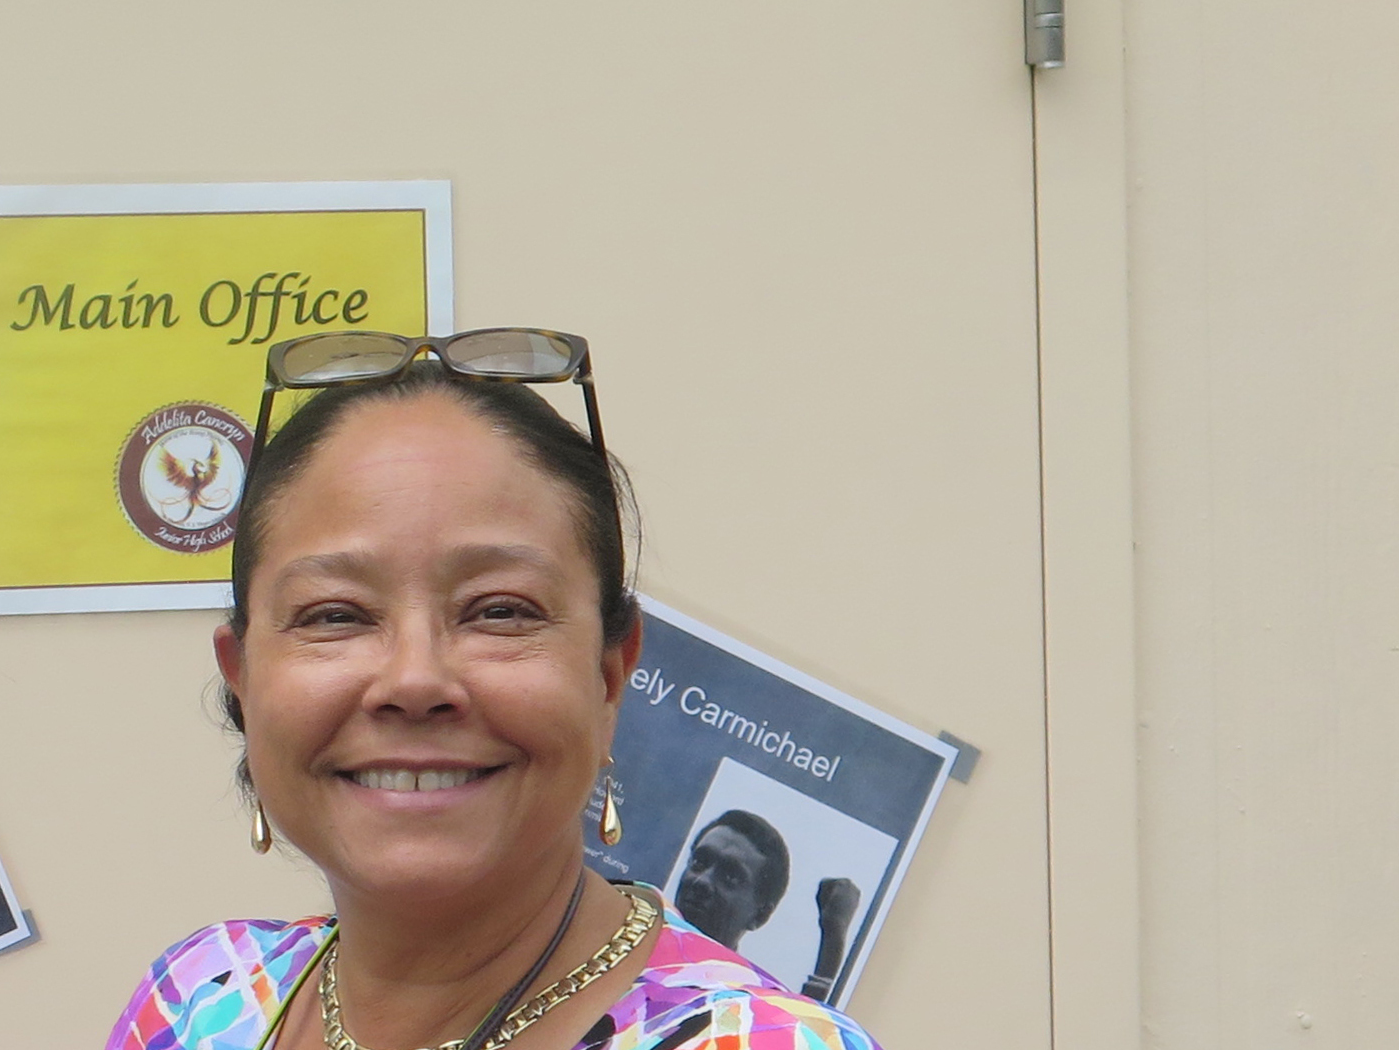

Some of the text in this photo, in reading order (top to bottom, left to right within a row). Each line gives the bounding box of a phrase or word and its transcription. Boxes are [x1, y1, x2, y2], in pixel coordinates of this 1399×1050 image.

[10, 271, 370, 345] Main Office
[141, 408, 191, 445] Addelita
[194, 409, 246, 442] Cancryn
[154, 526, 183, 545] Junior
[182, 531, 206, 552] High
[680, 686, 841, 782] Carmichael
[603, 854, 629, 874] during
